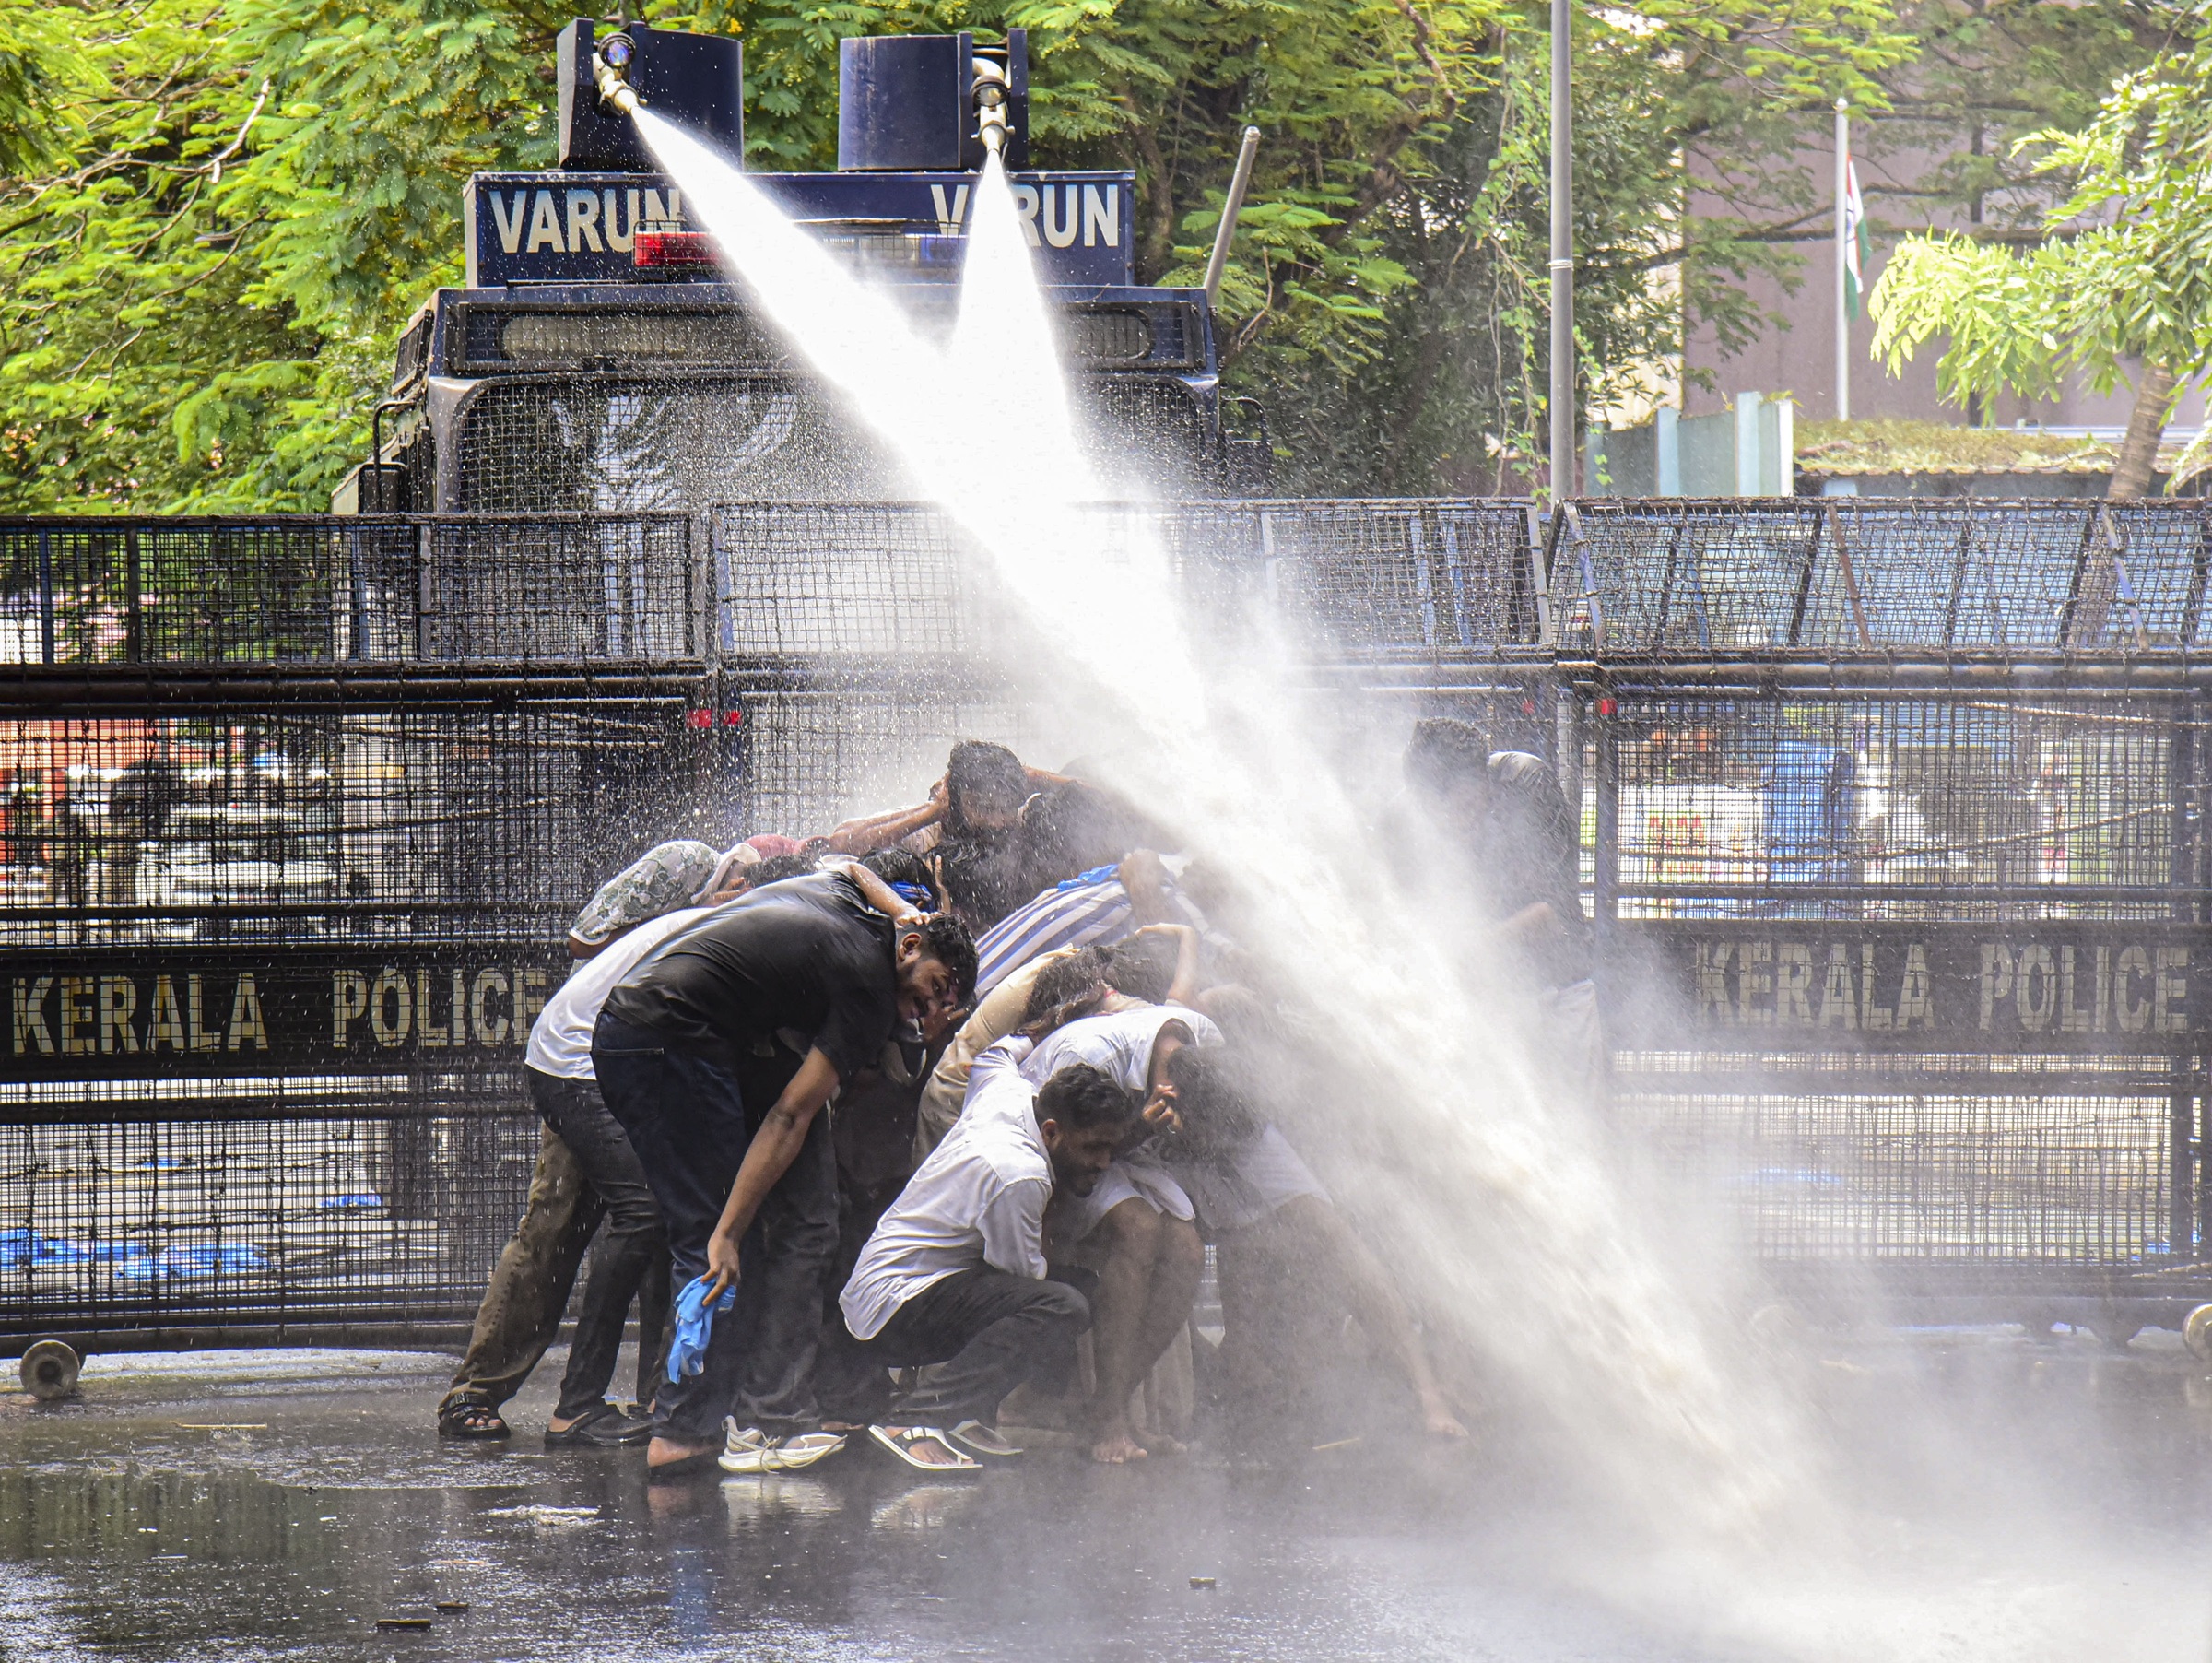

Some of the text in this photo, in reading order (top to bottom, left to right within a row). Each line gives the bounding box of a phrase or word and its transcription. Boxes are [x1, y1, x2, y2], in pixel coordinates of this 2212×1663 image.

[489, 189, 680, 253] VARUN
[931, 184, 1118, 248] VRUN
[12, 967, 547, 1056] KERALA POLICE
[1696, 942, 2188, 1034] KERALA POLICE
